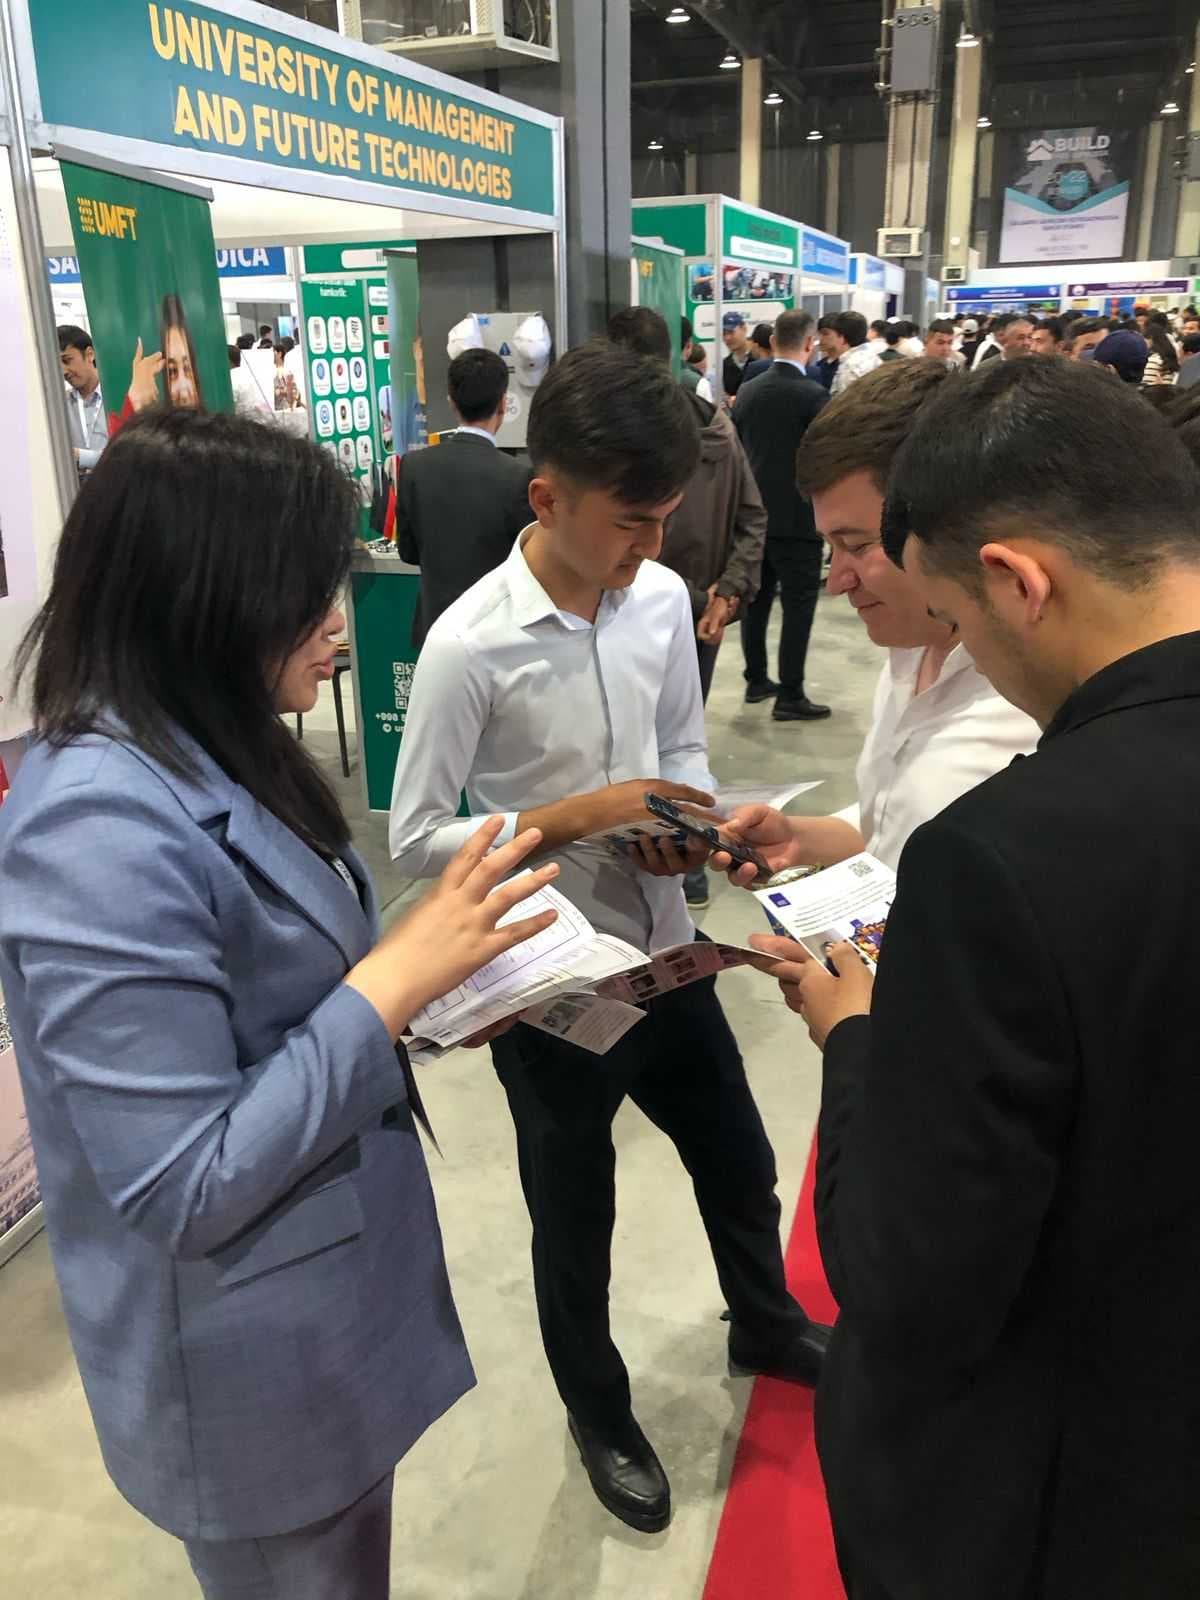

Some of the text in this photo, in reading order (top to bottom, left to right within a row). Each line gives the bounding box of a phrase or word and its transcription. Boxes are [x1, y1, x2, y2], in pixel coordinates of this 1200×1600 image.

[149, 4, 514, 155] UNIVERSITY OF MANAGEMENT
[174, 85, 512, 200] AND FUTURE TECHNOLOGIES
[1055, 135, 1111, 152] BUILD
[93, 201, 136, 240] UMFT
[49, 257, 80, 274] SA
